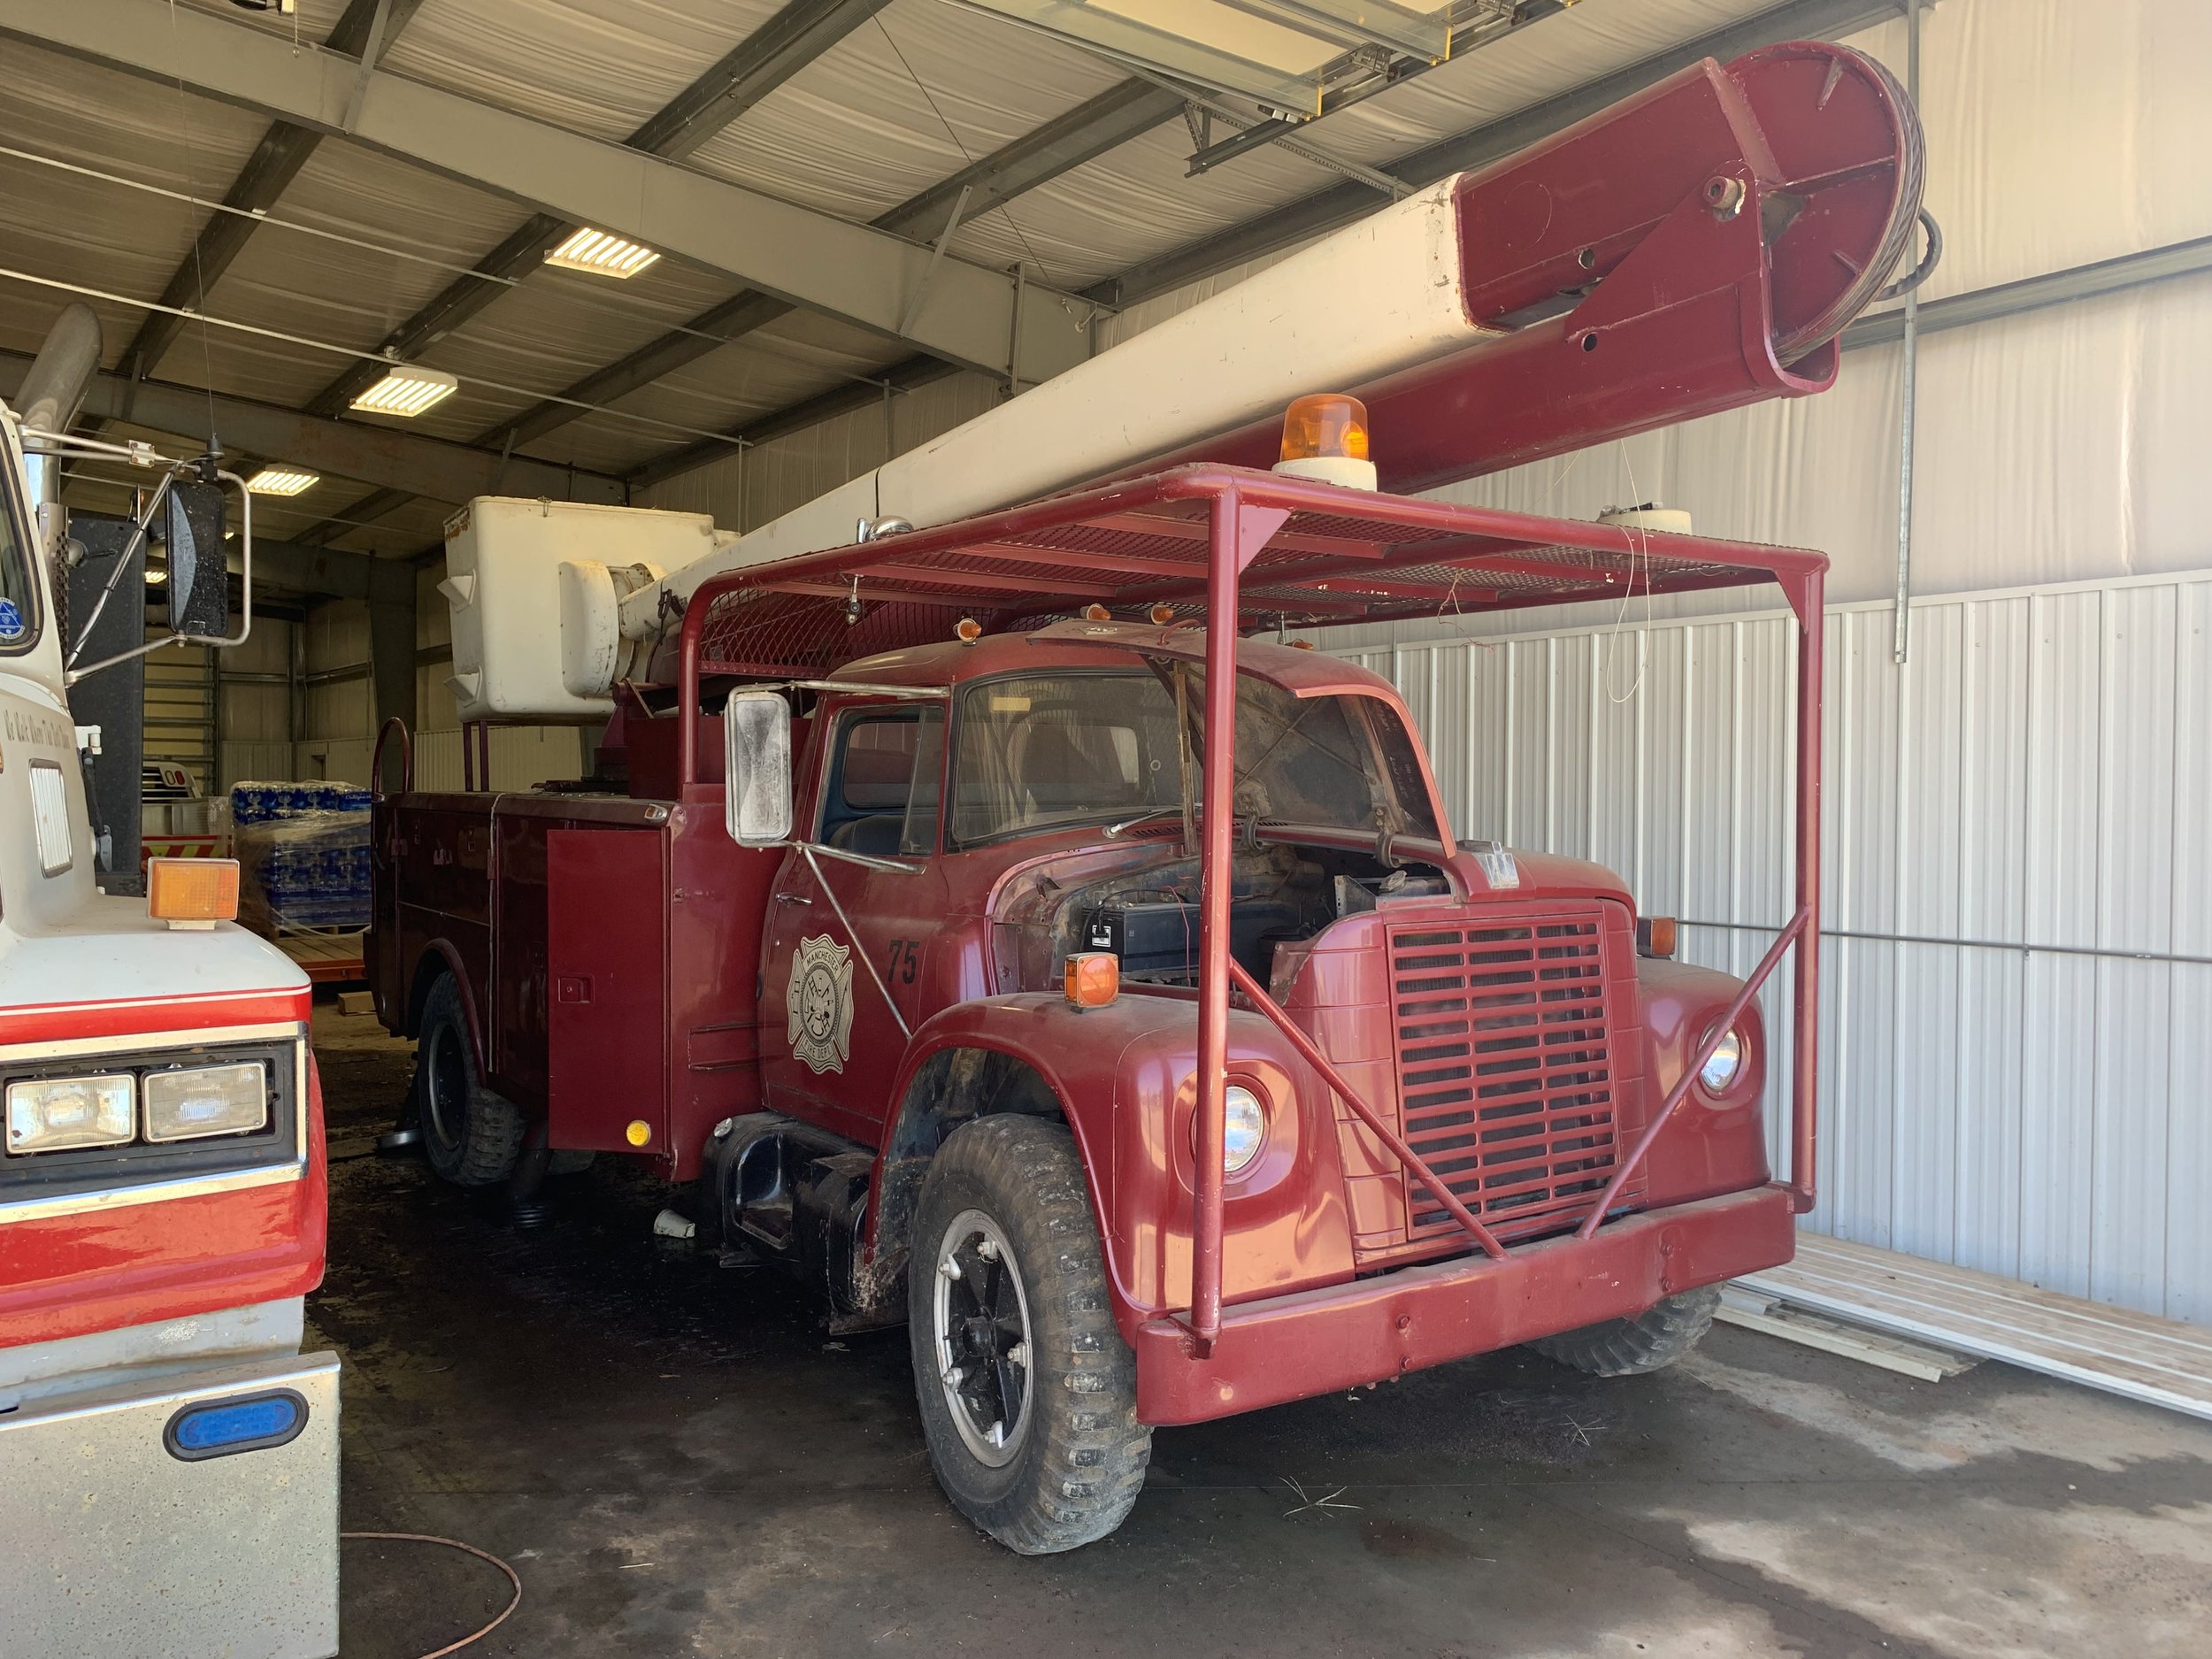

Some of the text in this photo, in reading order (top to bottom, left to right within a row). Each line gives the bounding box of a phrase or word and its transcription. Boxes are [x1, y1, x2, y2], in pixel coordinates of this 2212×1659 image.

[806, 950, 838, 974] MANCHESTER
[887, 940, 920, 984] 75
[804, 1039, 816, 1057] FIRE
